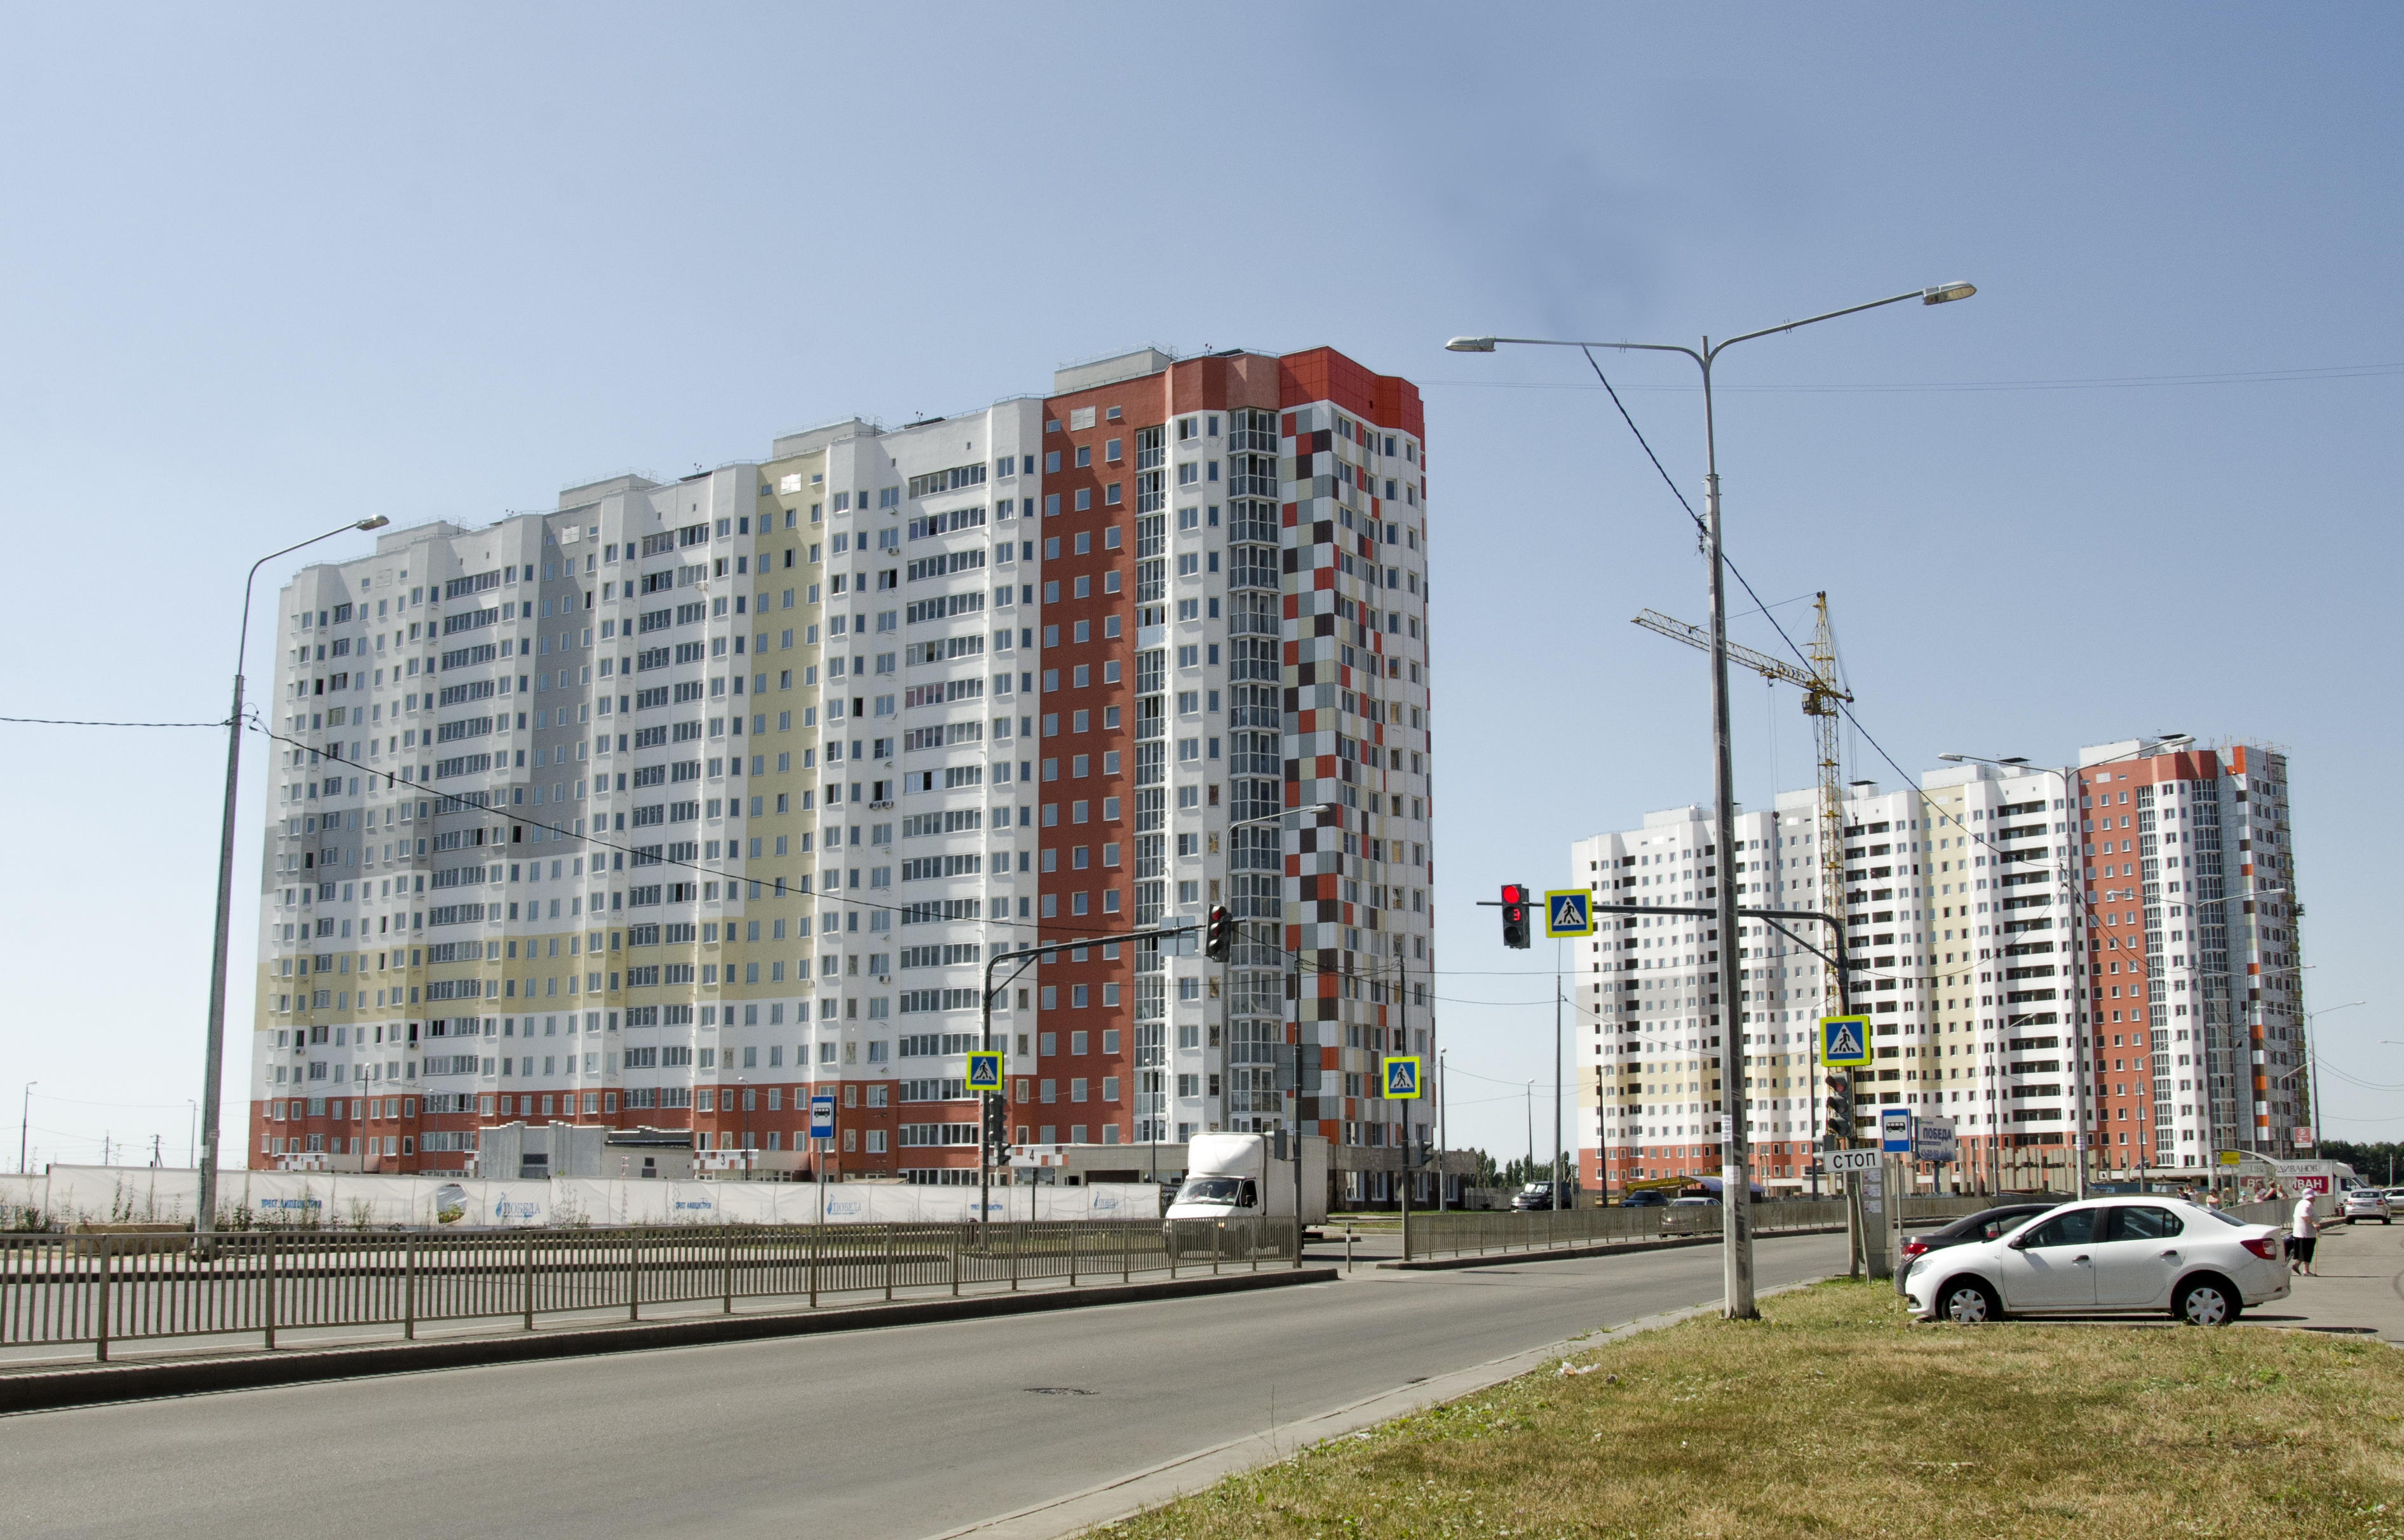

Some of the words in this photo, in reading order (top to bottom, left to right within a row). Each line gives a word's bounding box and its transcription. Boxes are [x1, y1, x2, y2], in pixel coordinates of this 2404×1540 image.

[1922, 1127, 1952, 1142] ПОБЕДА
[720, 1154, 726, 1166] 3
[1029, 1149, 1035, 1162] 4
[1833, 1152, 1875, 1169] СТОП
[503, 1201, 541, 1214] ПОБЕДА
[833, 1202, 862, 1212] ПОБЕДА
